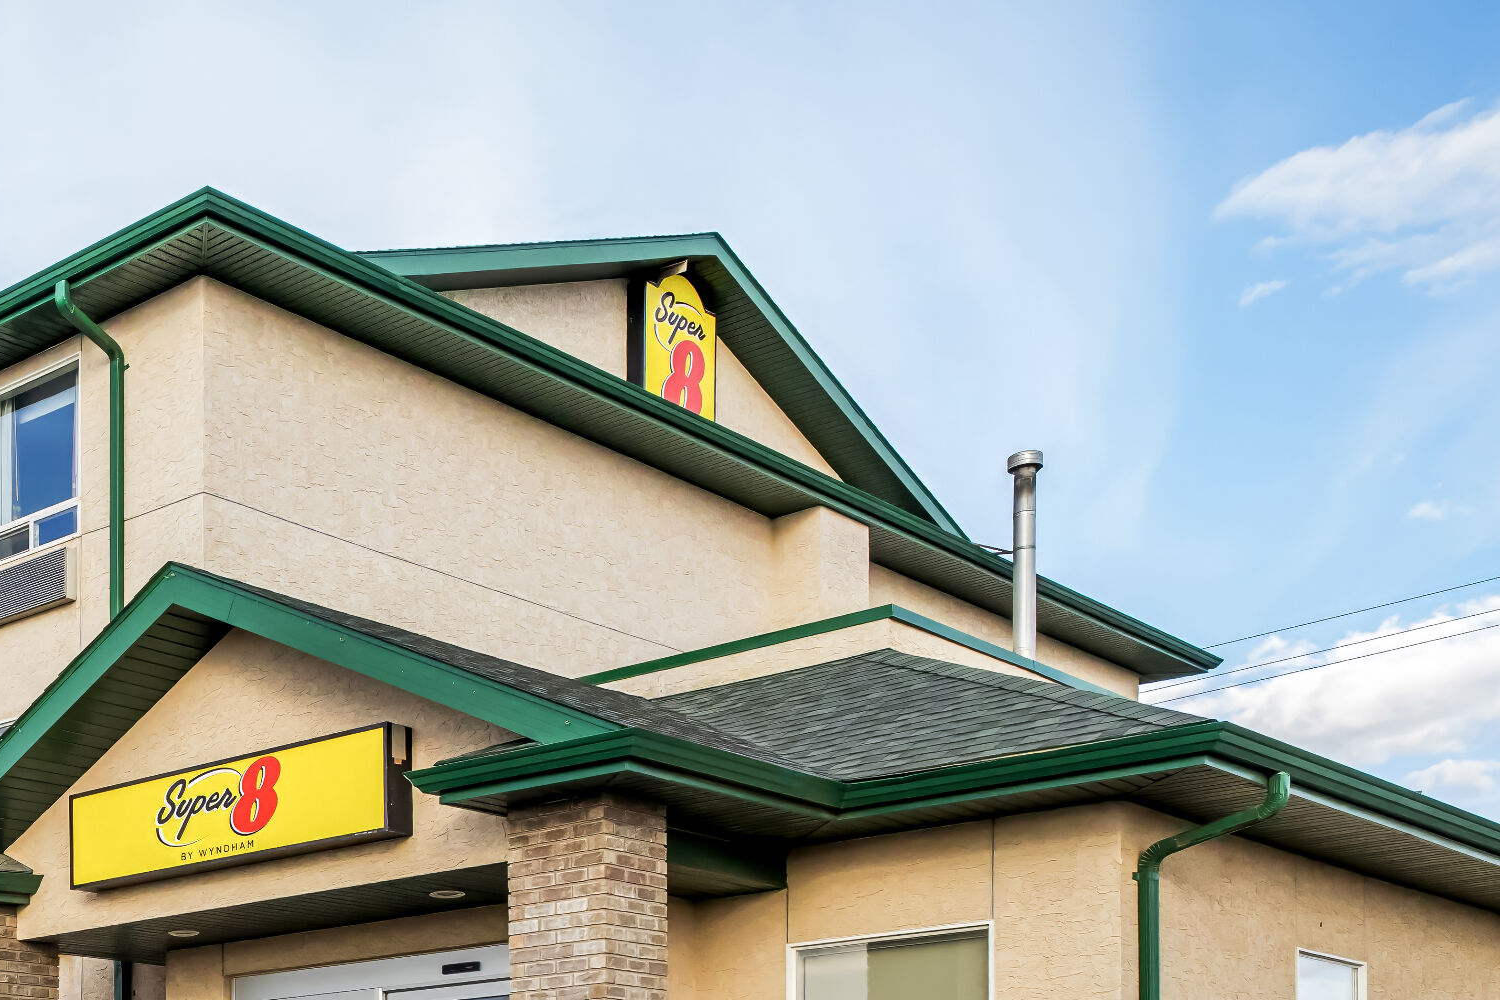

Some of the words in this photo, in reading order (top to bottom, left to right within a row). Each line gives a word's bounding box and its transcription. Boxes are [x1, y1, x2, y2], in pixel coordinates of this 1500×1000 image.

[654, 291, 706, 345] Super
[661, 340, 705, 415] 8
[155, 778, 237, 842] Super
[230, 755, 282, 836] 8
[181, 852, 193, 861] BY
[199, 839, 254, 858] WYNDHAM
